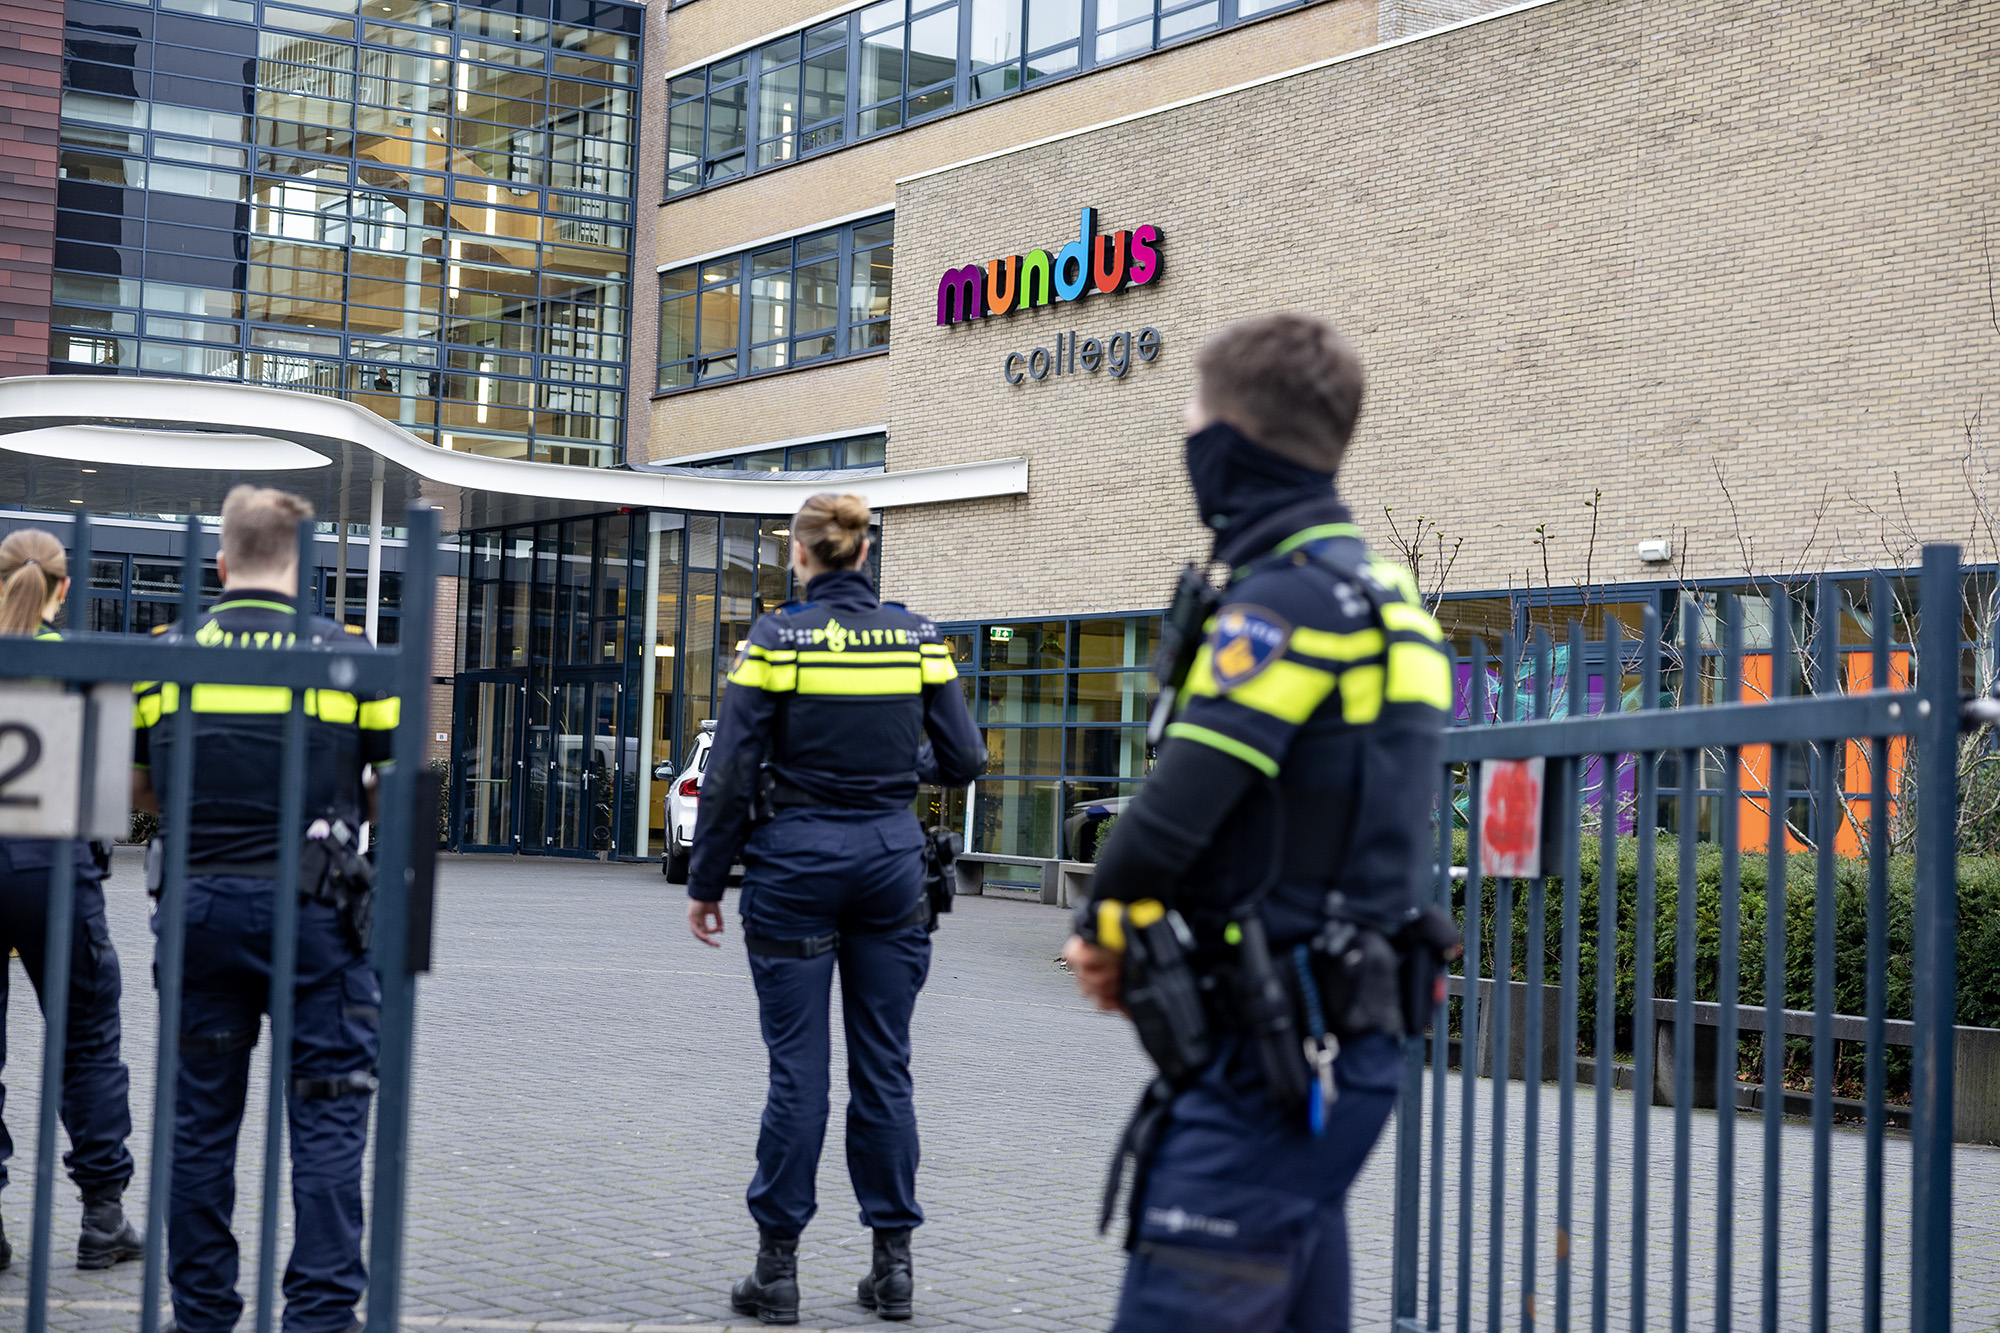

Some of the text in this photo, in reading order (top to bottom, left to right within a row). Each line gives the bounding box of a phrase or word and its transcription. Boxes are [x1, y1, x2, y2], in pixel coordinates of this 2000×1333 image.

[937, 207, 1164, 326] mundus
[1004, 326, 1162, 384] college
[0, 722, 42, 809] 2
